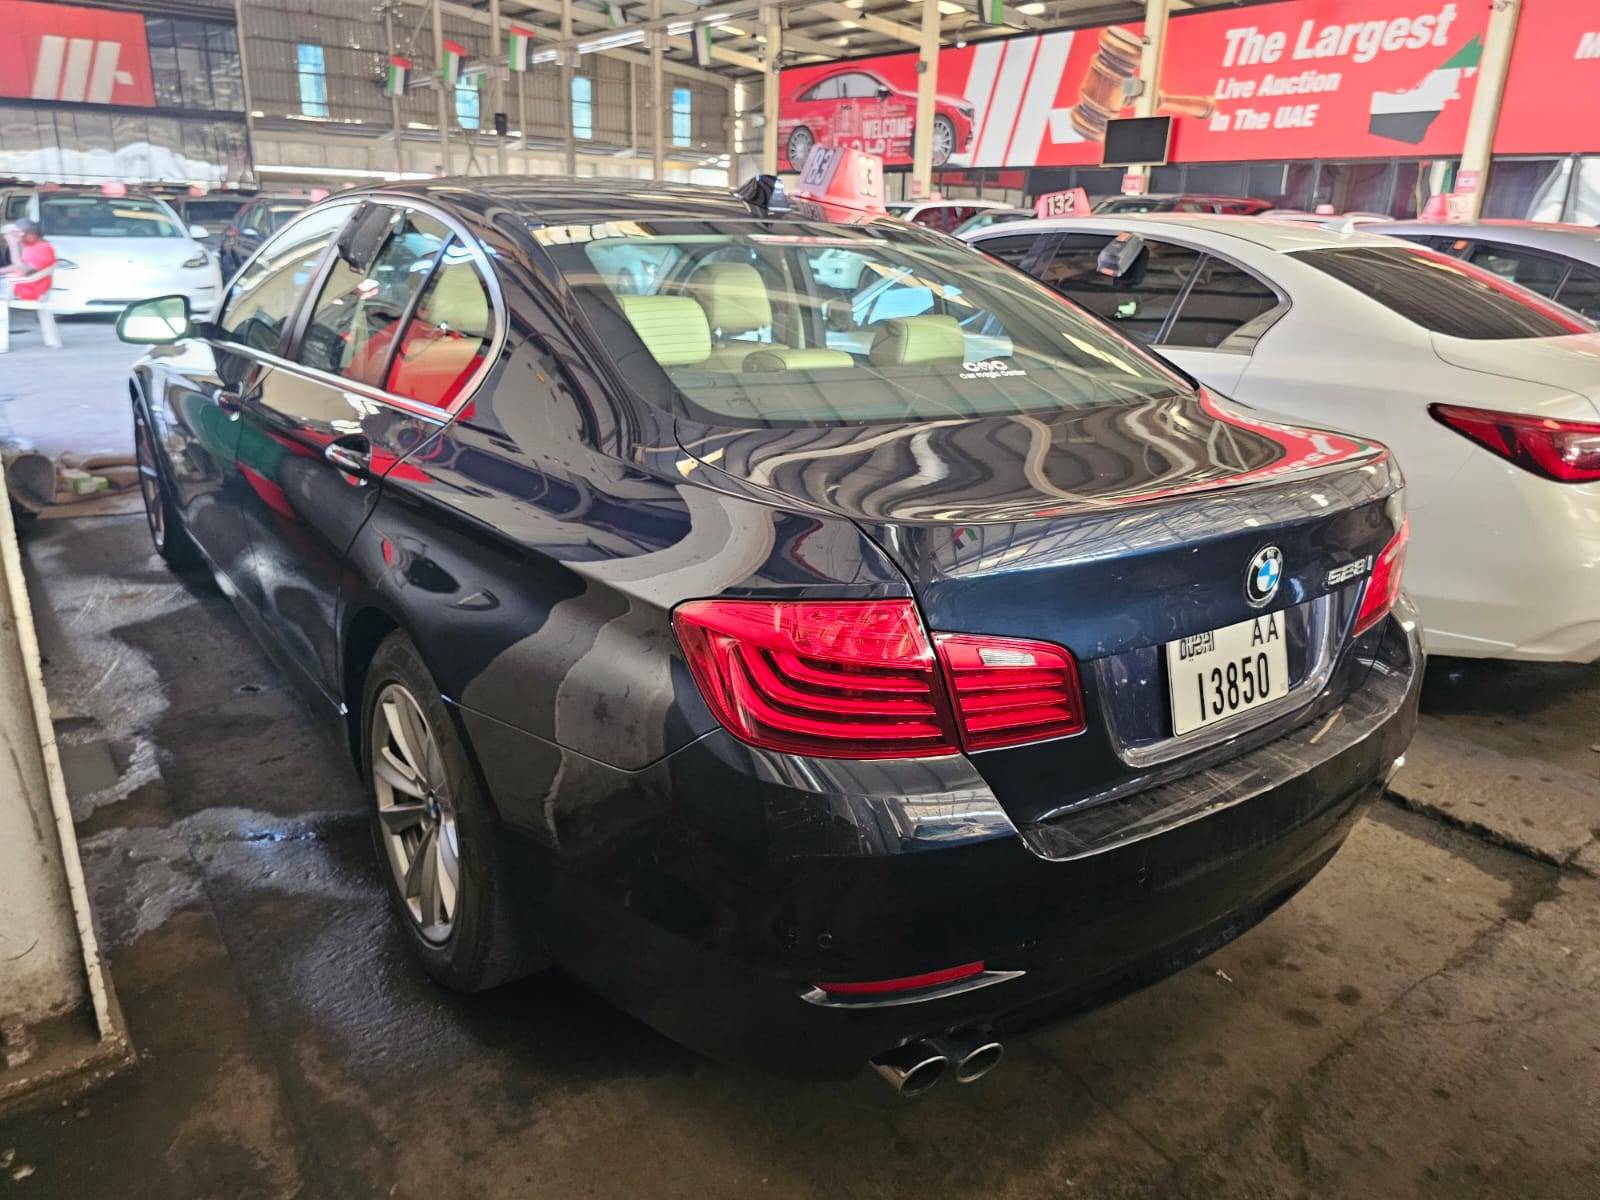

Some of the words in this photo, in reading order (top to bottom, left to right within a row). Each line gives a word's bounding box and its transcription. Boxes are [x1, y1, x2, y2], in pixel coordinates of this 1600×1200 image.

[1222, 26, 1286, 67] The
[1293, 3, 1457, 63] Largest
[1215, 78, 1256, 100] Live
[1257, 70, 1342, 97] Auction
[863, 117, 913, 139] WELCOME
[1209, 111, 1230, 132] In
[1234, 108, 1270, 131] The
[1274, 104, 1320, 129] UAE
[804, 147, 836, 186] 83
[1047, 191, 1075, 217] 132
[1251, 613, 1279, 647] AA
[1197, 651, 1271, 722] 13850
